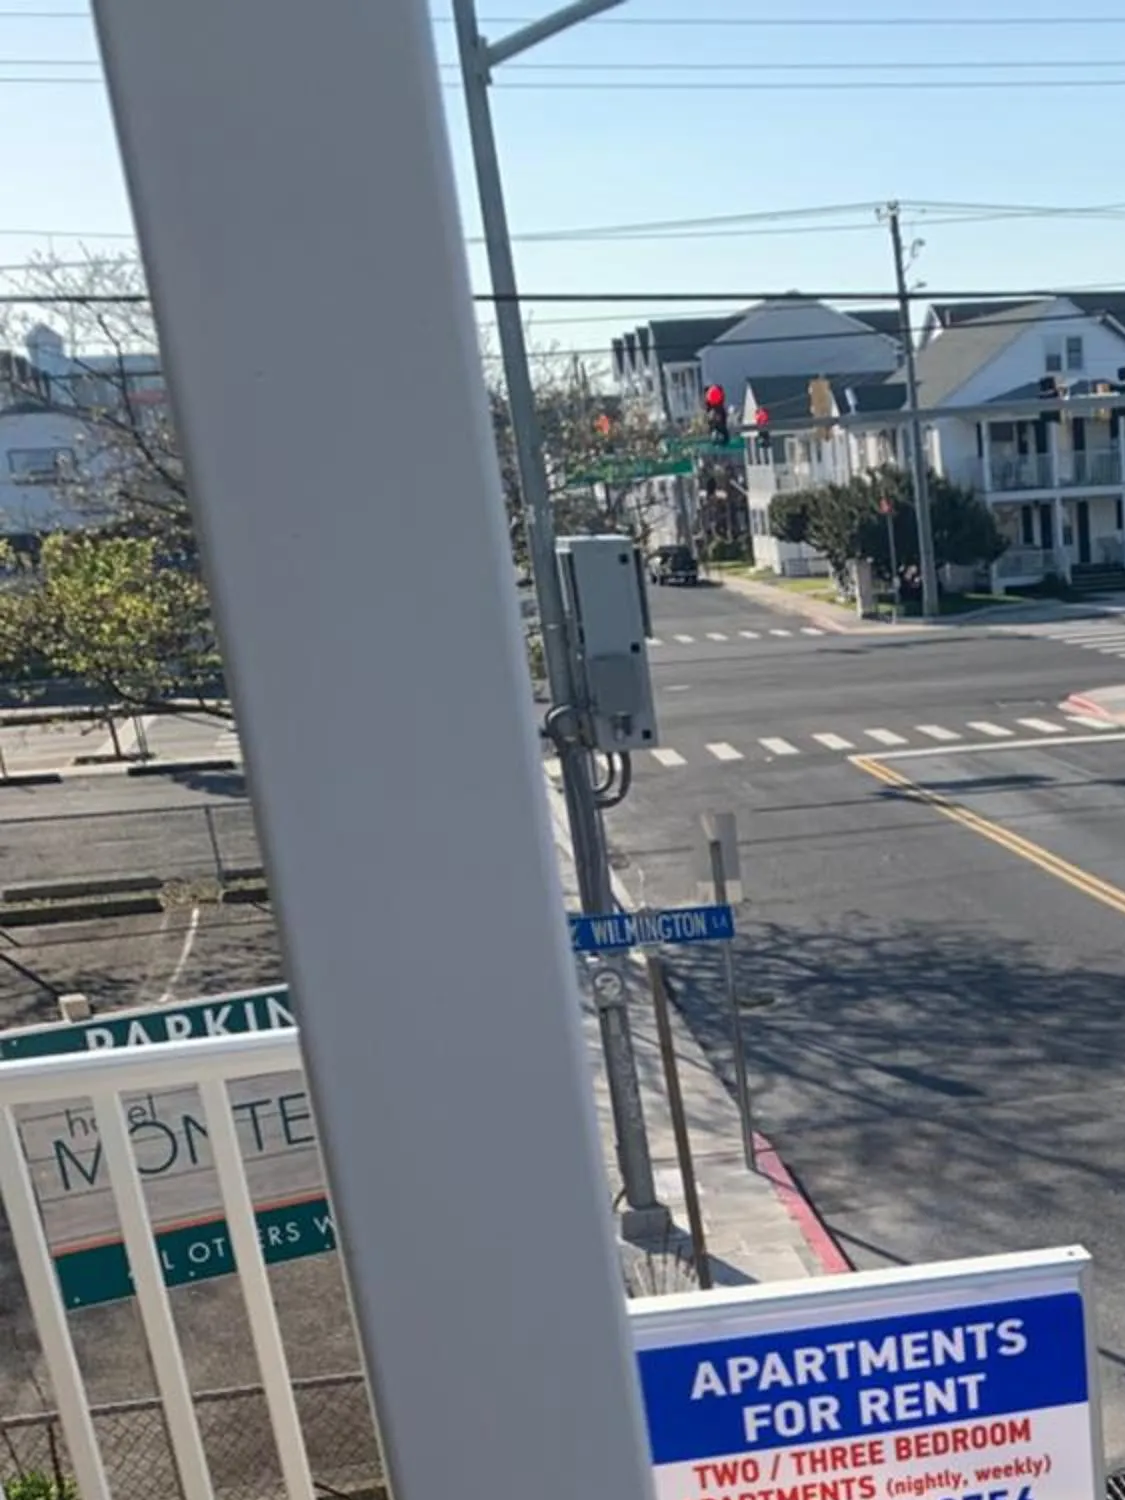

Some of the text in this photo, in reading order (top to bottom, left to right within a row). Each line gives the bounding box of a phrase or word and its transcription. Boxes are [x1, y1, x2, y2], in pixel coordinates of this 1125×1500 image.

[591, 912, 707, 945] WILMINGTON
[85, 997, 296, 1051] PARKIN
[54, 1092, 315, 1191] MONTE
[65, 1094, 156, 1139] hel
[188, 1221, 301, 1263] OTRS
[690, 1319, 1028, 1400] APARTMENTS
[743, 1373, 986, 1442] FOR RENT
[693, 1418, 1032, 1490] TWO / THREE BEDROOM
[886, 1464, 968, 1499] (nightly,
[975, 1453, 1052, 1482] weekly)
